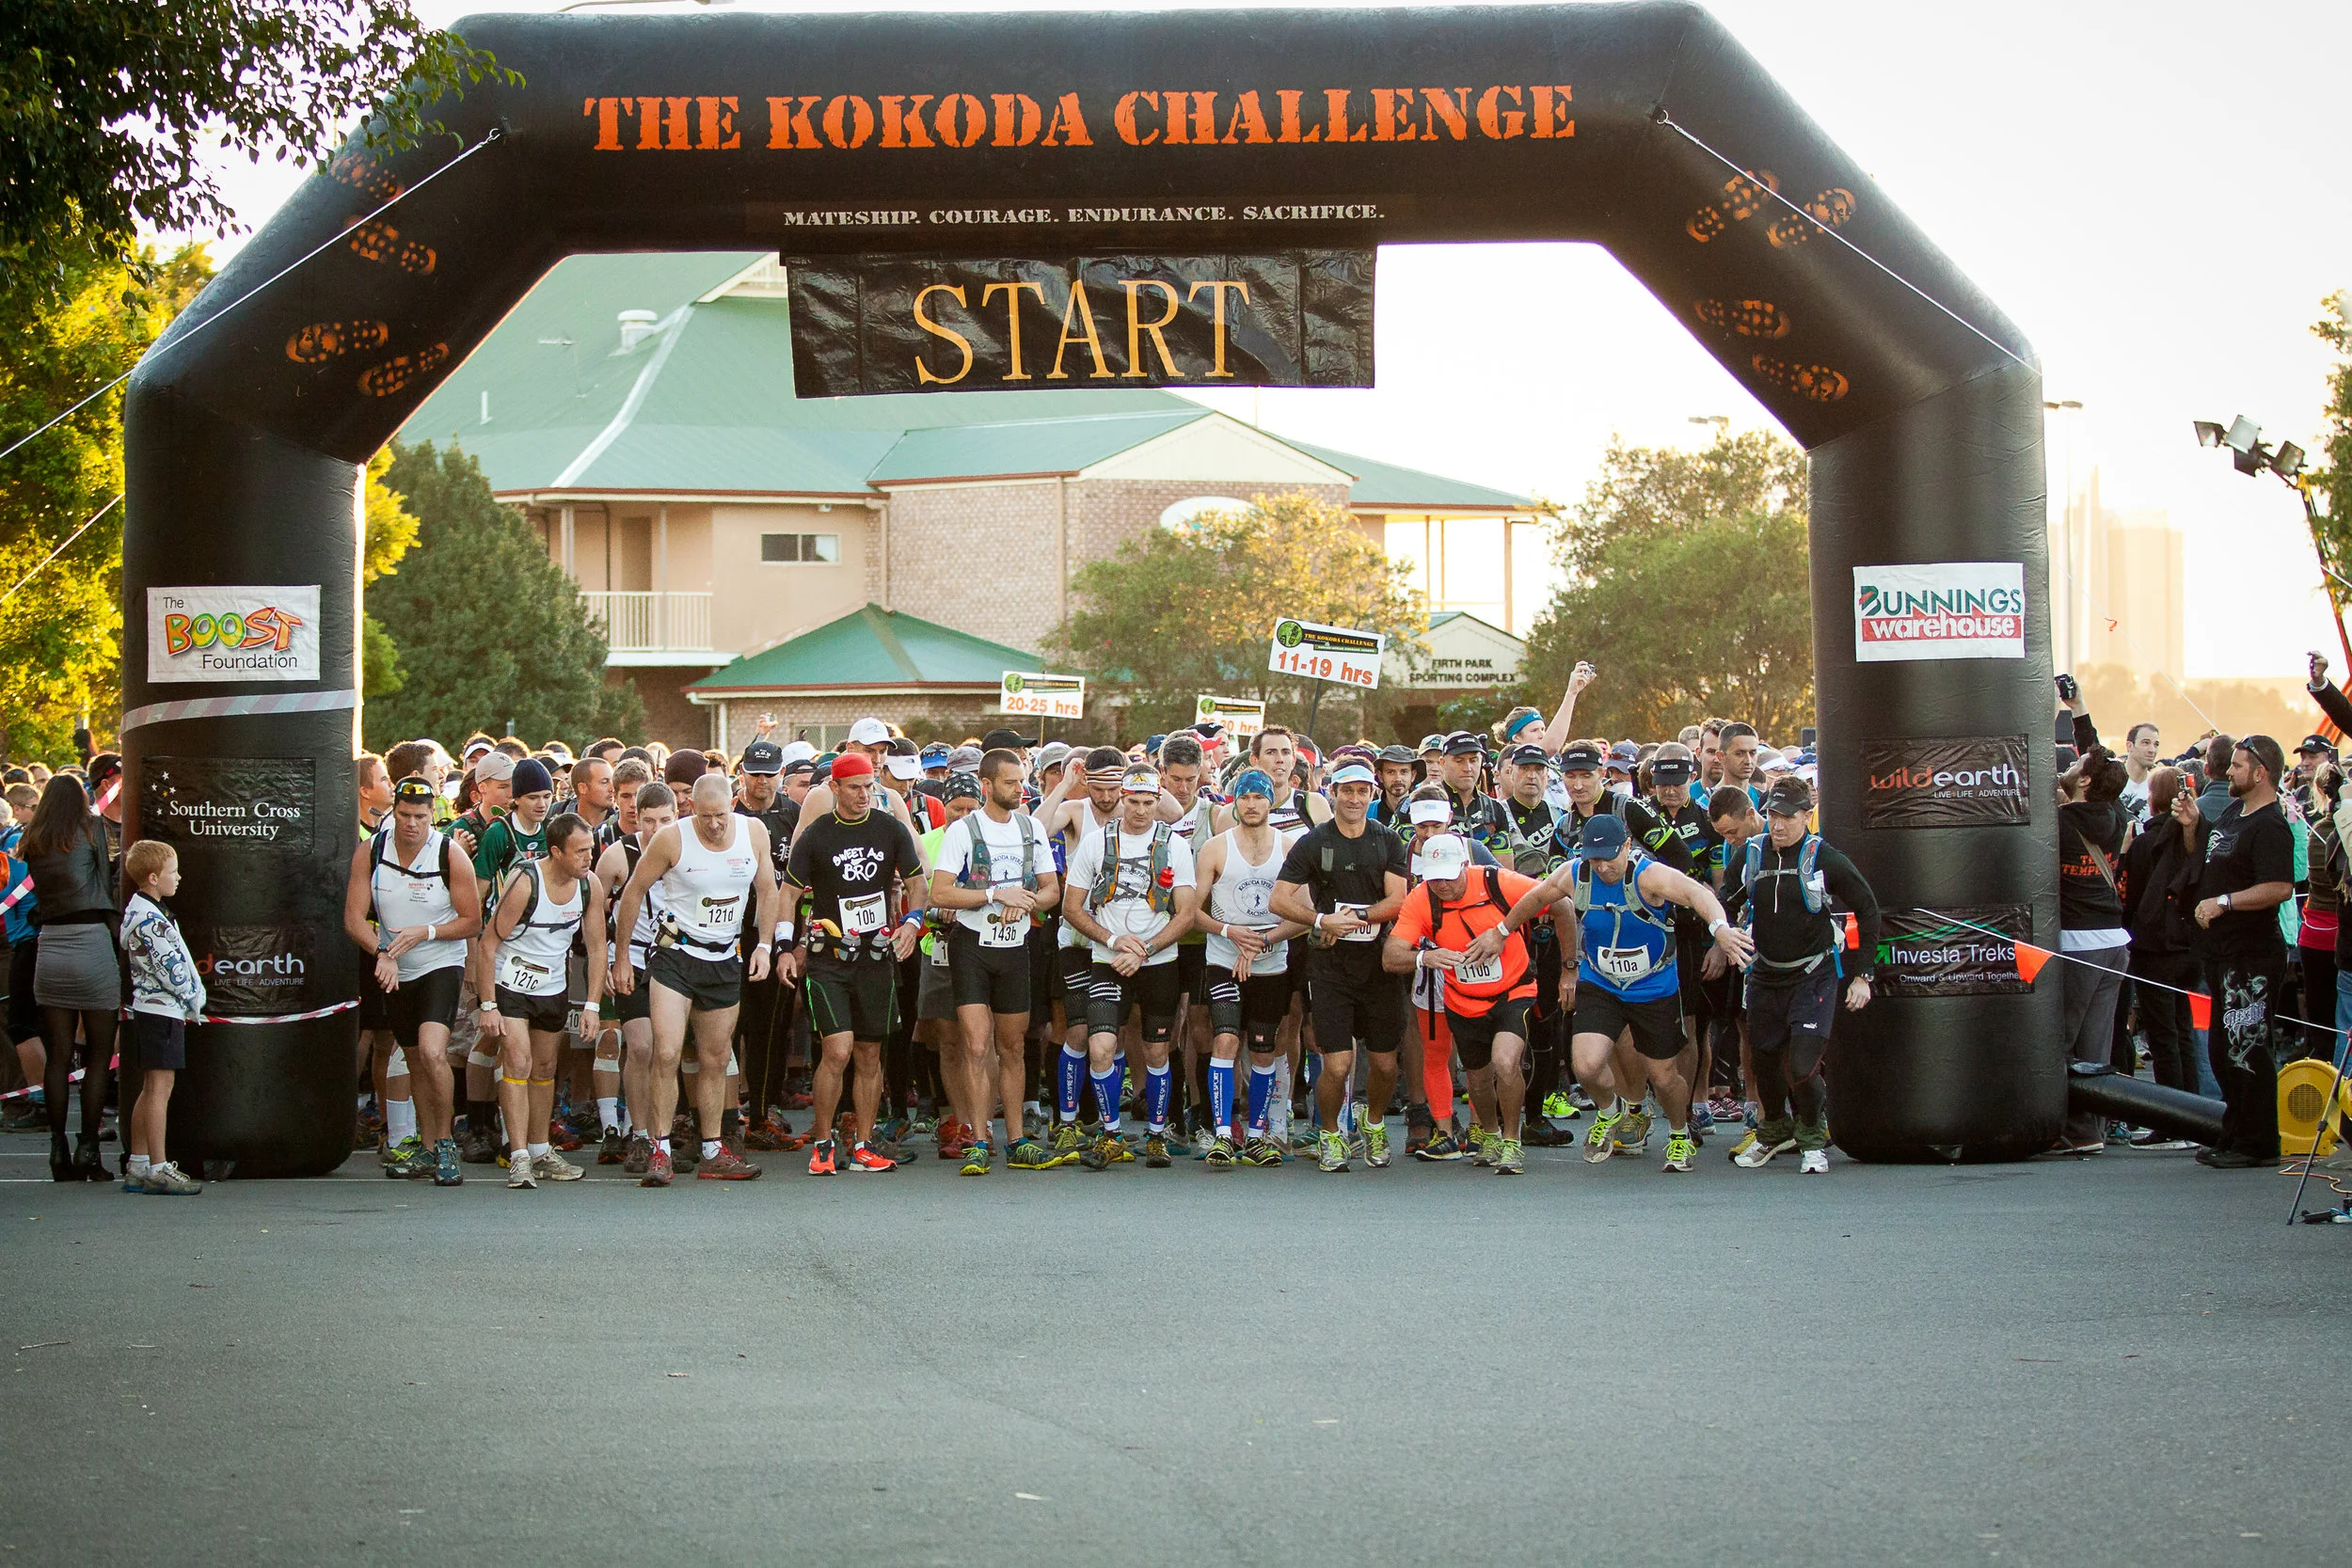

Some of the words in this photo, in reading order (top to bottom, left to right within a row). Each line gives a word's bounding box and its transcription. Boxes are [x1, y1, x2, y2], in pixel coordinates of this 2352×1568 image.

[583, 96, 740, 150] THE
[766, 92, 1093, 150] KOKODA
[1114, 85, 1575, 146] CHALLENGE
[783, 211, 919, 226] MATESHIP.
[929, 208, 1059, 225] COURAGE.
[1068, 206, 1232, 223] ENDURANCE.
[1243, 203, 1386, 221] SACRIFICE.
[913, 278, 1250, 386] START
[164, 596, 184, 609] The
[1859, 585, 2022, 616] BUNNINGS
[164, 607, 303, 656] BOOST
[1869, 610, 2015, 640] warehouse
[202, 654, 298, 669] Foundation
[1279, 651, 1332, 678] 11-19
[1341, 662, 1373, 686] hrs
[1432, 659, 1462, 669] FIRTH
[1465, 658, 1493, 669] PARK
[1409, 673, 1463, 683] SPORTING
[1465, 673, 1516, 683] COMPLEX
[1007, 696, 1048, 713] 20-25
[1055, 700, 1079, 716] hrs
[1240, 721, 1259, 734] hrs
[1869, 763, 2020, 789] wildearth
[1933, 790, 1951, 799] LIVE
[1979, 788, 2021, 798] ADVENTURE
[169, 800, 246, 817] Southern
[253, 801, 301, 818] Cross
[189, 819, 279, 840] University
[833, 847, 864, 866] SWEET
[866, 847, 884, 862] AS
[842, 862, 878, 881] BRO
[708, 907, 734, 924] 121d
[855, 908, 876, 927] 10b
[992, 926, 1017, 942] 143b
[1891, 945, 1961, 964] Investa
[1966, 942, 2016, 962] Treks
[196, 952, 305, 974] dearth
[1461, 962, 1490, 978] 110b
[1609, 958, 1638, 973] 110a
[259, 977, 305, 986] ADVENTURE
[513, 970, 539, 990] 121c
[1899, 973, 1935, 983] Onward
[1948, 971, 1984, 983] Upward
[1986, 971, 2019, 983] Togethe
